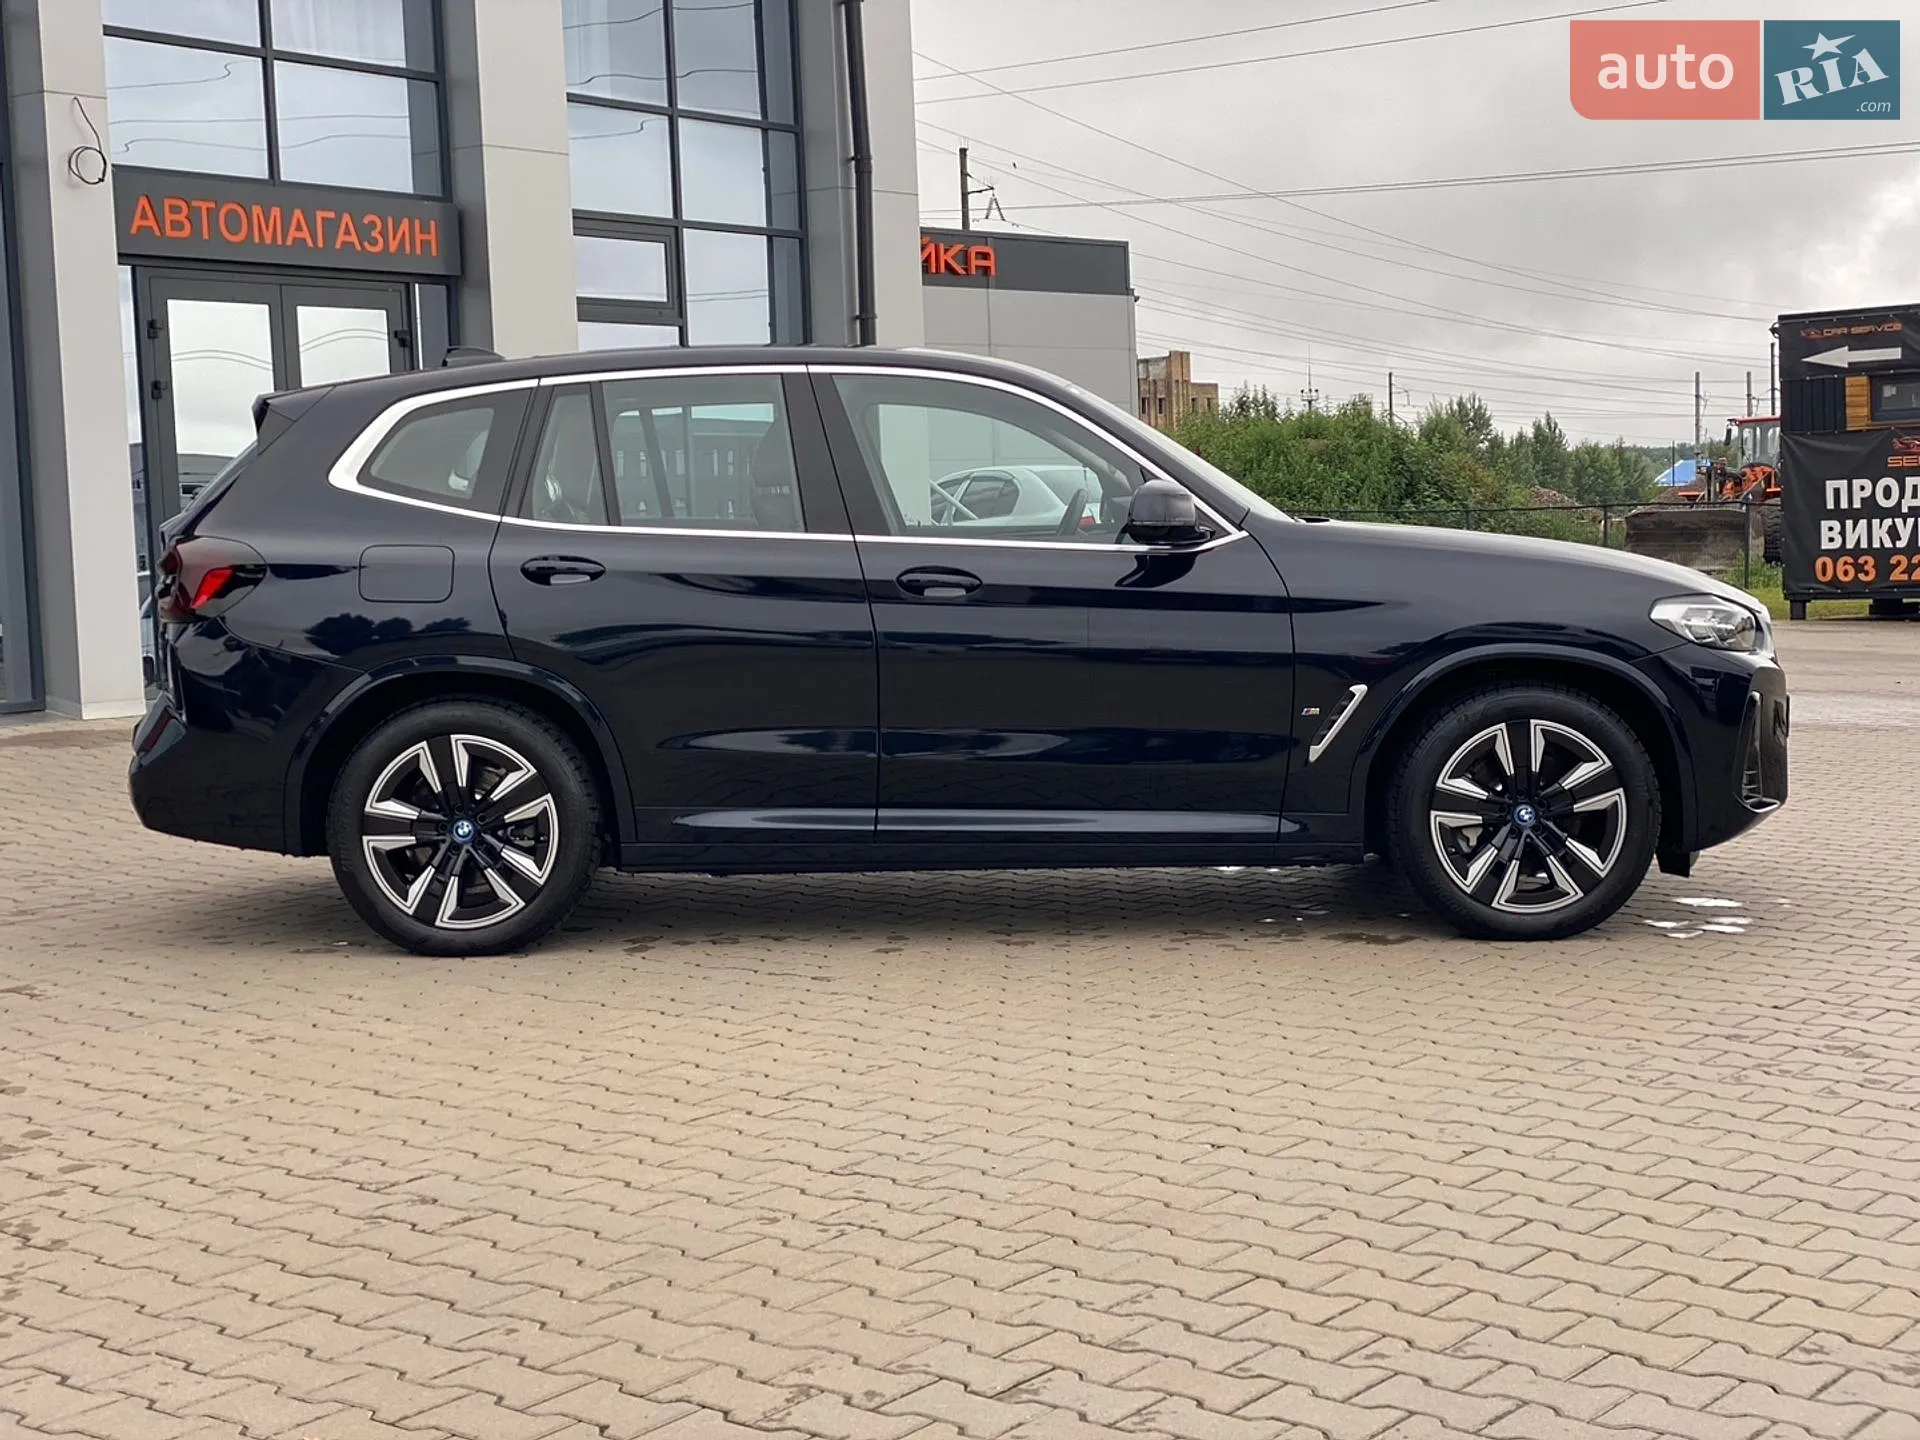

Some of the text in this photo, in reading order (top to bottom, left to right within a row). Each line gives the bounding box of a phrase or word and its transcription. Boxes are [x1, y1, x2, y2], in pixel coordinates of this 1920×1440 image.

[130, 194, 439, 257] АВТОМАГАЗИН
[1887, 455, 1920, 467] SE
[1821, 518, 1920, 549] ВИКУ
[1815, 555, 1876, 582] 063
